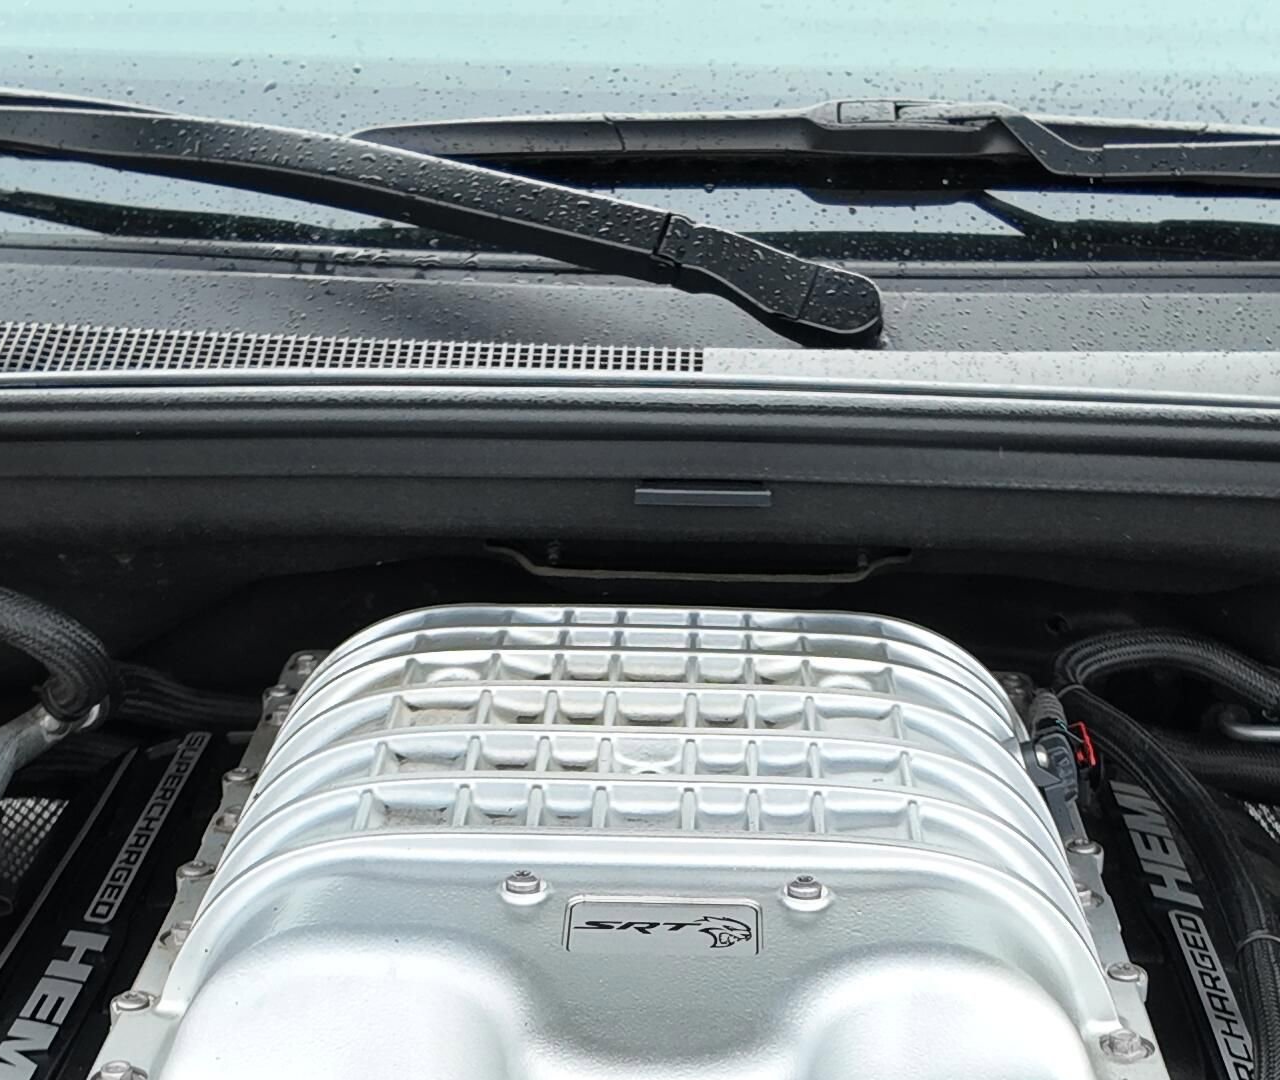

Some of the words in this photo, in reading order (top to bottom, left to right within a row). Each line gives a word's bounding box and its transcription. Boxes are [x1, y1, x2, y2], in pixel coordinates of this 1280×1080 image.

[87, 733, 209, 922] SUPERCHARGED
[1109, 780, 1204, 910] HEMI
[573, 920, 702, 935] SRT
